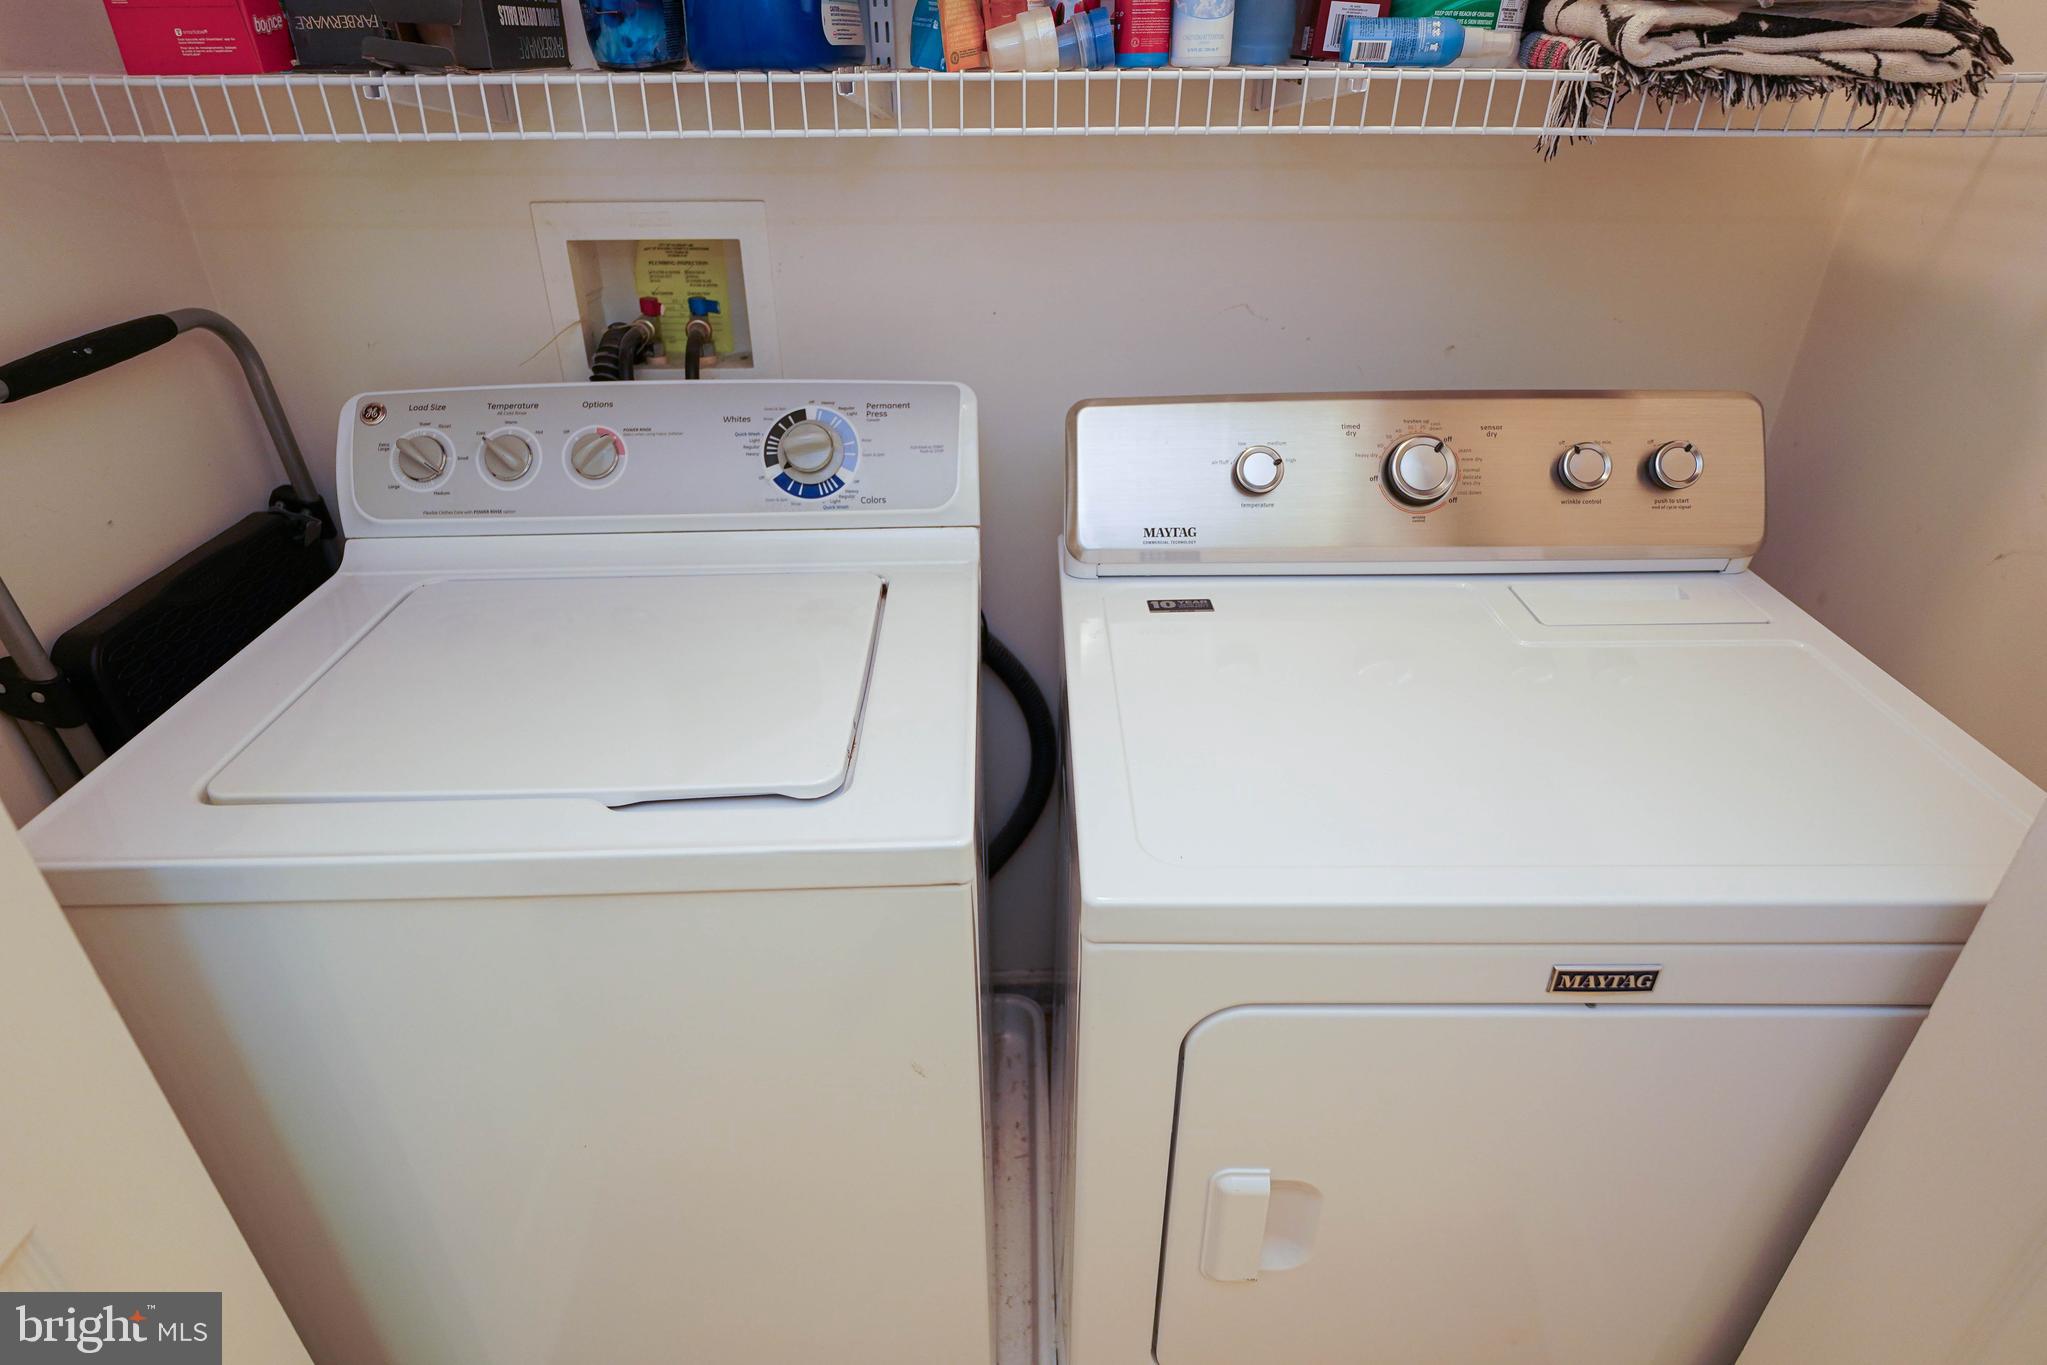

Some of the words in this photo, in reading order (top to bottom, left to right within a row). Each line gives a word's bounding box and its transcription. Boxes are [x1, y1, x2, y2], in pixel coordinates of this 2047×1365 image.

[497, 5, 518, 26] BALLS
[253, 14, 283, 33] bounce
[294, 14, 379, 30] FARBERWARE
[408, 404, 429, 412] Load
[430, 403, 447, 412] Size
[487, 402, 539, 411] Temperature
[581, 401, 614, 409] Options
[860, 496, 887, 504] Colors
[1143, 527, 1197, 538] MAYTAG
[1150, 600, 1176, 609] 10
[1558, 974, 1653, 988] MAYTAG
